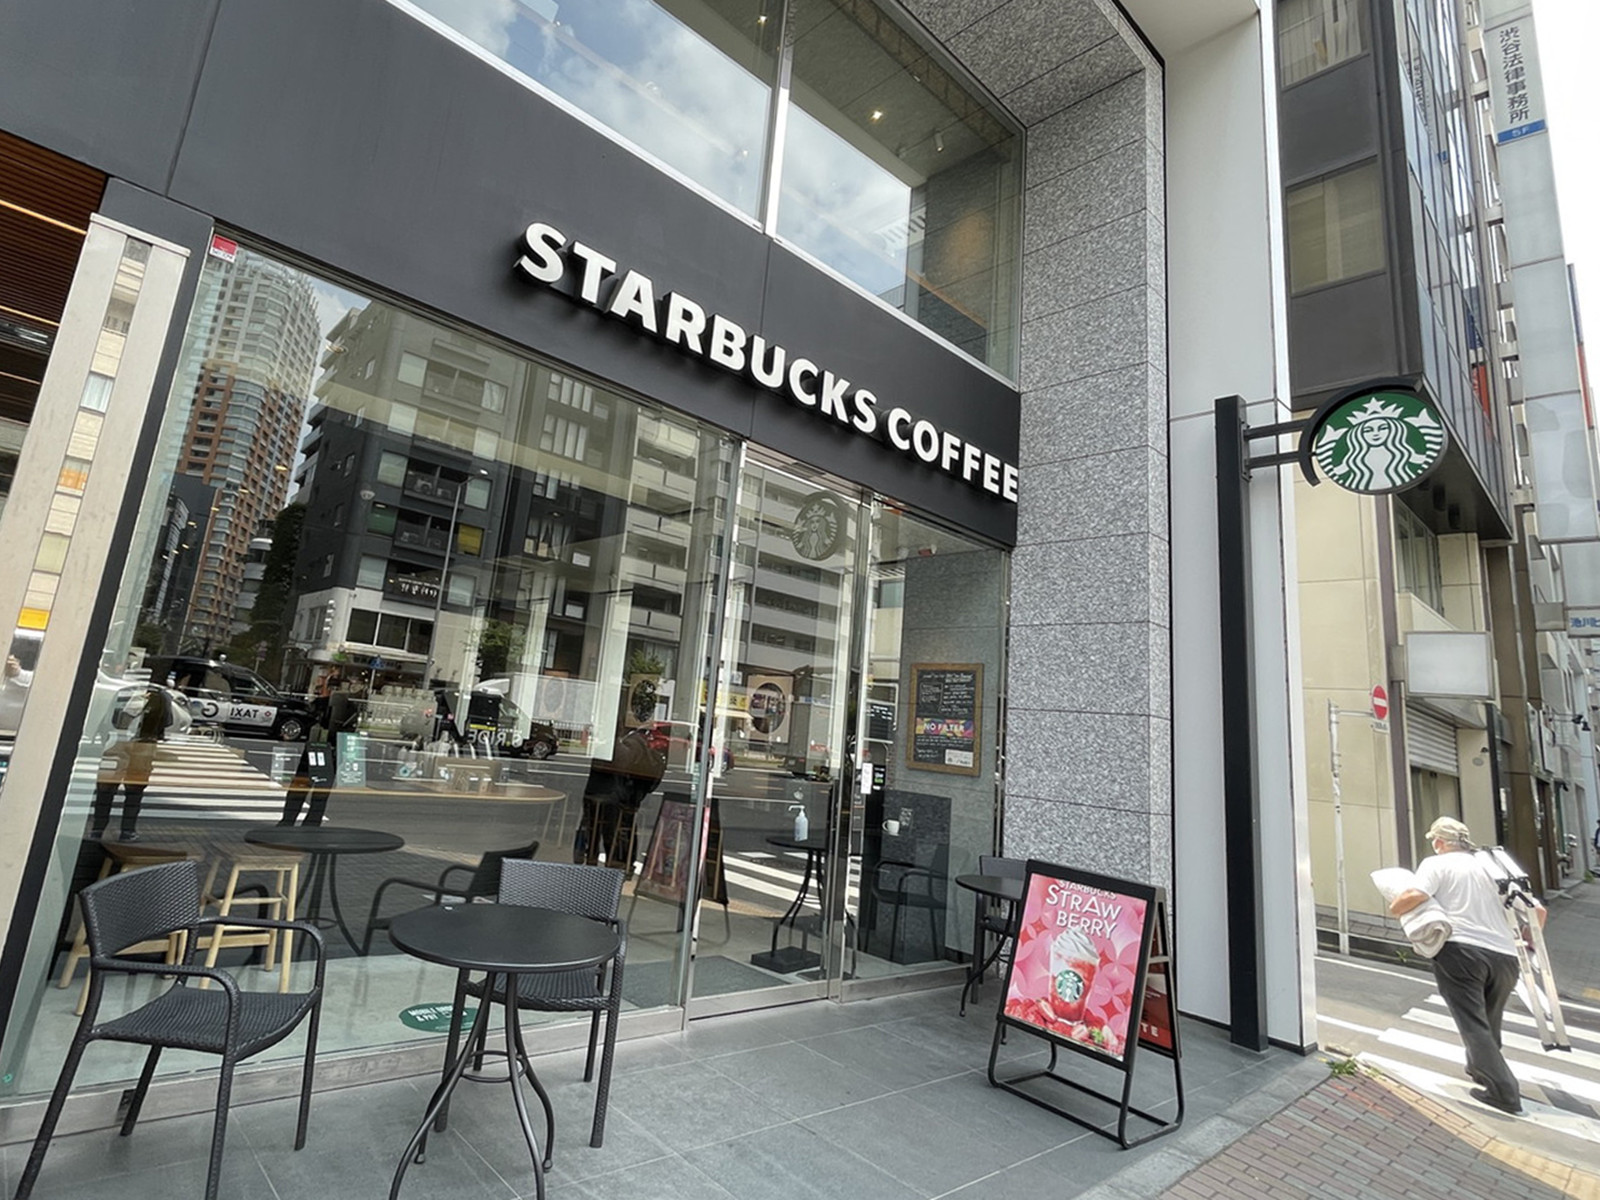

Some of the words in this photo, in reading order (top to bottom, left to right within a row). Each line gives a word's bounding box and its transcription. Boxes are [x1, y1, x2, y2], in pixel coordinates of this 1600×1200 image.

[1500, 26, 1530, 124] 渋谷法律事務所
[1512, 126, 1531, 138] 5F
[517, 222, 878, 435] STARBUCKS
[888, 406, 1019, 503] COFFEE
[923, 722, 936, 731] NO
[938, 723, 965, 733] FILTER
[1046, 883, 1122, 921] STRAW
[1056, 910, 1117, 940] BERRY
